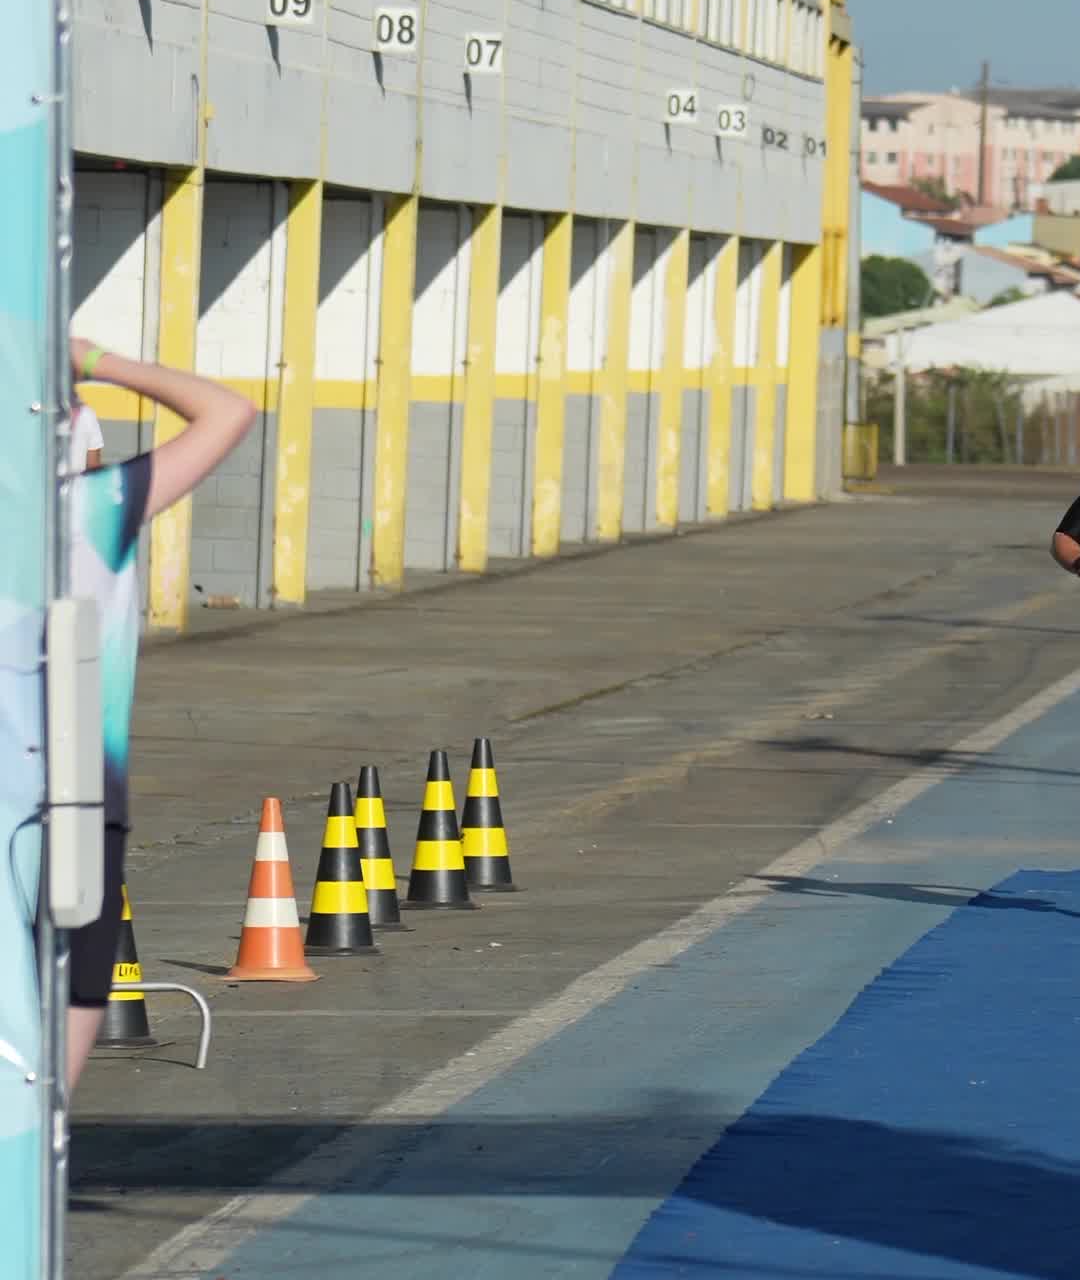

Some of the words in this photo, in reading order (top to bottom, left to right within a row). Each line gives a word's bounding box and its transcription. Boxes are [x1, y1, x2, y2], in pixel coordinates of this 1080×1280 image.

[376, 14, 415, 44] 08
[466, 38, 502, 67] 07
[667, 94, 697, 117] 04
[717, 110, 746, 132] 03
[762, 127, 788, 150] 02
[805, 137, 828, 156] 01
